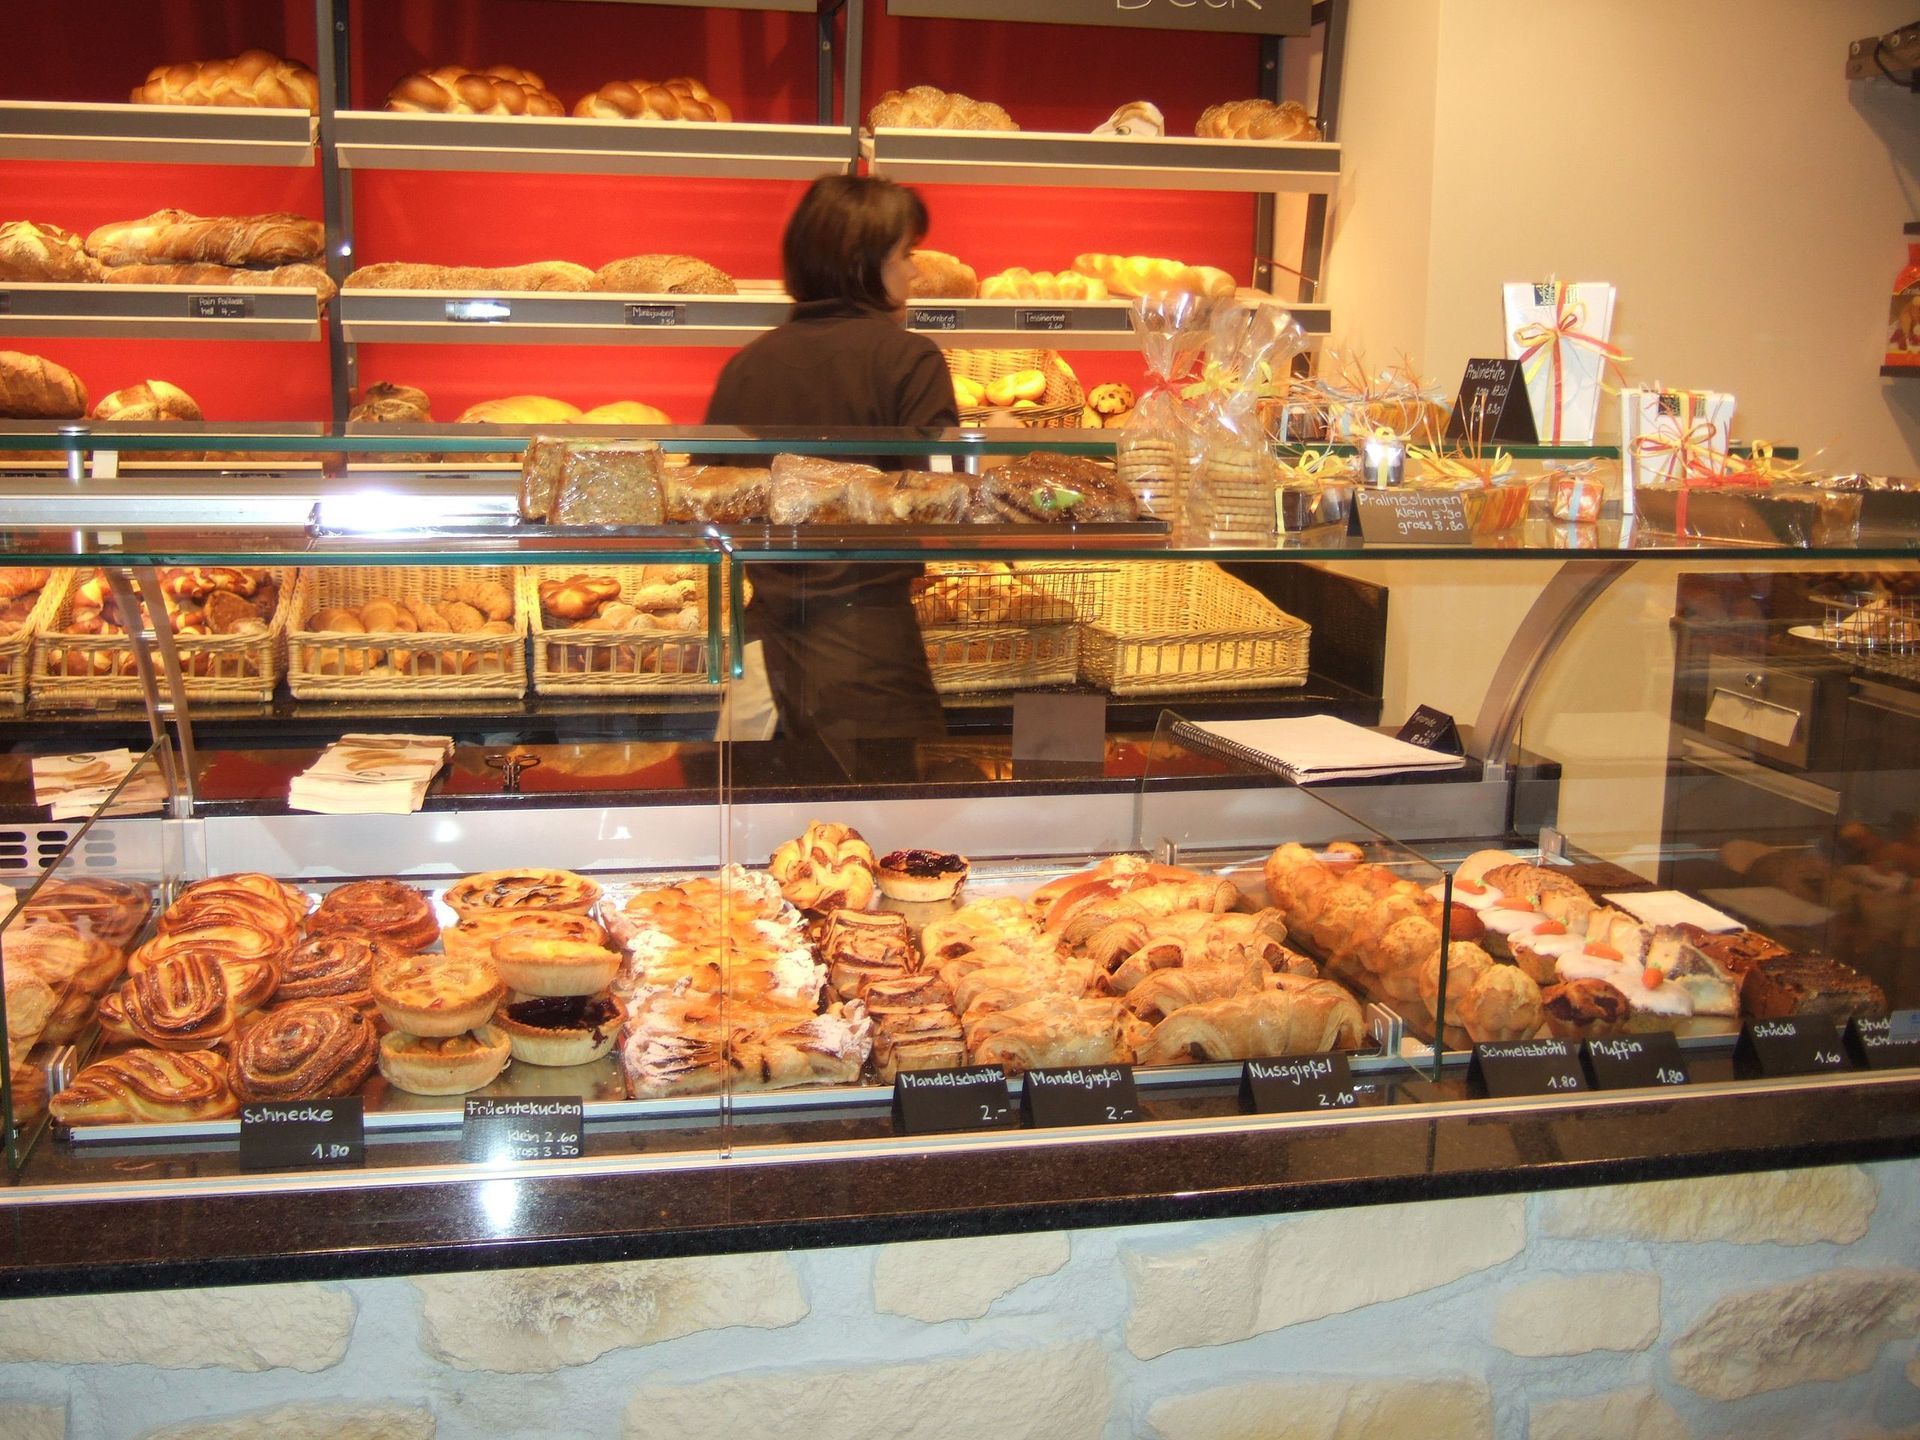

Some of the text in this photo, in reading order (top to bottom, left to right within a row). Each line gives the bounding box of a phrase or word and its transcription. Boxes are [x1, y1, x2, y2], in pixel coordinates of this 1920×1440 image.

[1358, 492, 1462, 512] Pralinestangen
[1398, 521, 1433, 535] gross
[1754, 1021, 1796, 1037] Stückli
[1480, 1039, 1567, 1058] Schmelzbrötli
[1589, 1040, 1643, 1060] Muffin
[1814, 1050, 1841, 1064] 1.60
[900, 1067, 1006, 1089] Mandelschnitte
[1030, 1067, 1122, 1089] Mandelgipfel
[1248, 1058, 1332, 1086] Nussgipfel
[1656, 1067, 1684, 1084] 1.80
[1547, 1075, 1577, 1089] 1.80
[1318, 1092, 1354, 1106] 2.10
[243, 1107, 334, 1124] Schnecke
[980, 1104, 1007, 1120] 2.-
[1106, 1106, 1133, 1120] 2.-
[543, 1131, 578, 1143] 2.60
[311, 1143, 351, 1159] 1.80
[542, 1144, 580, 1157] 3.50
